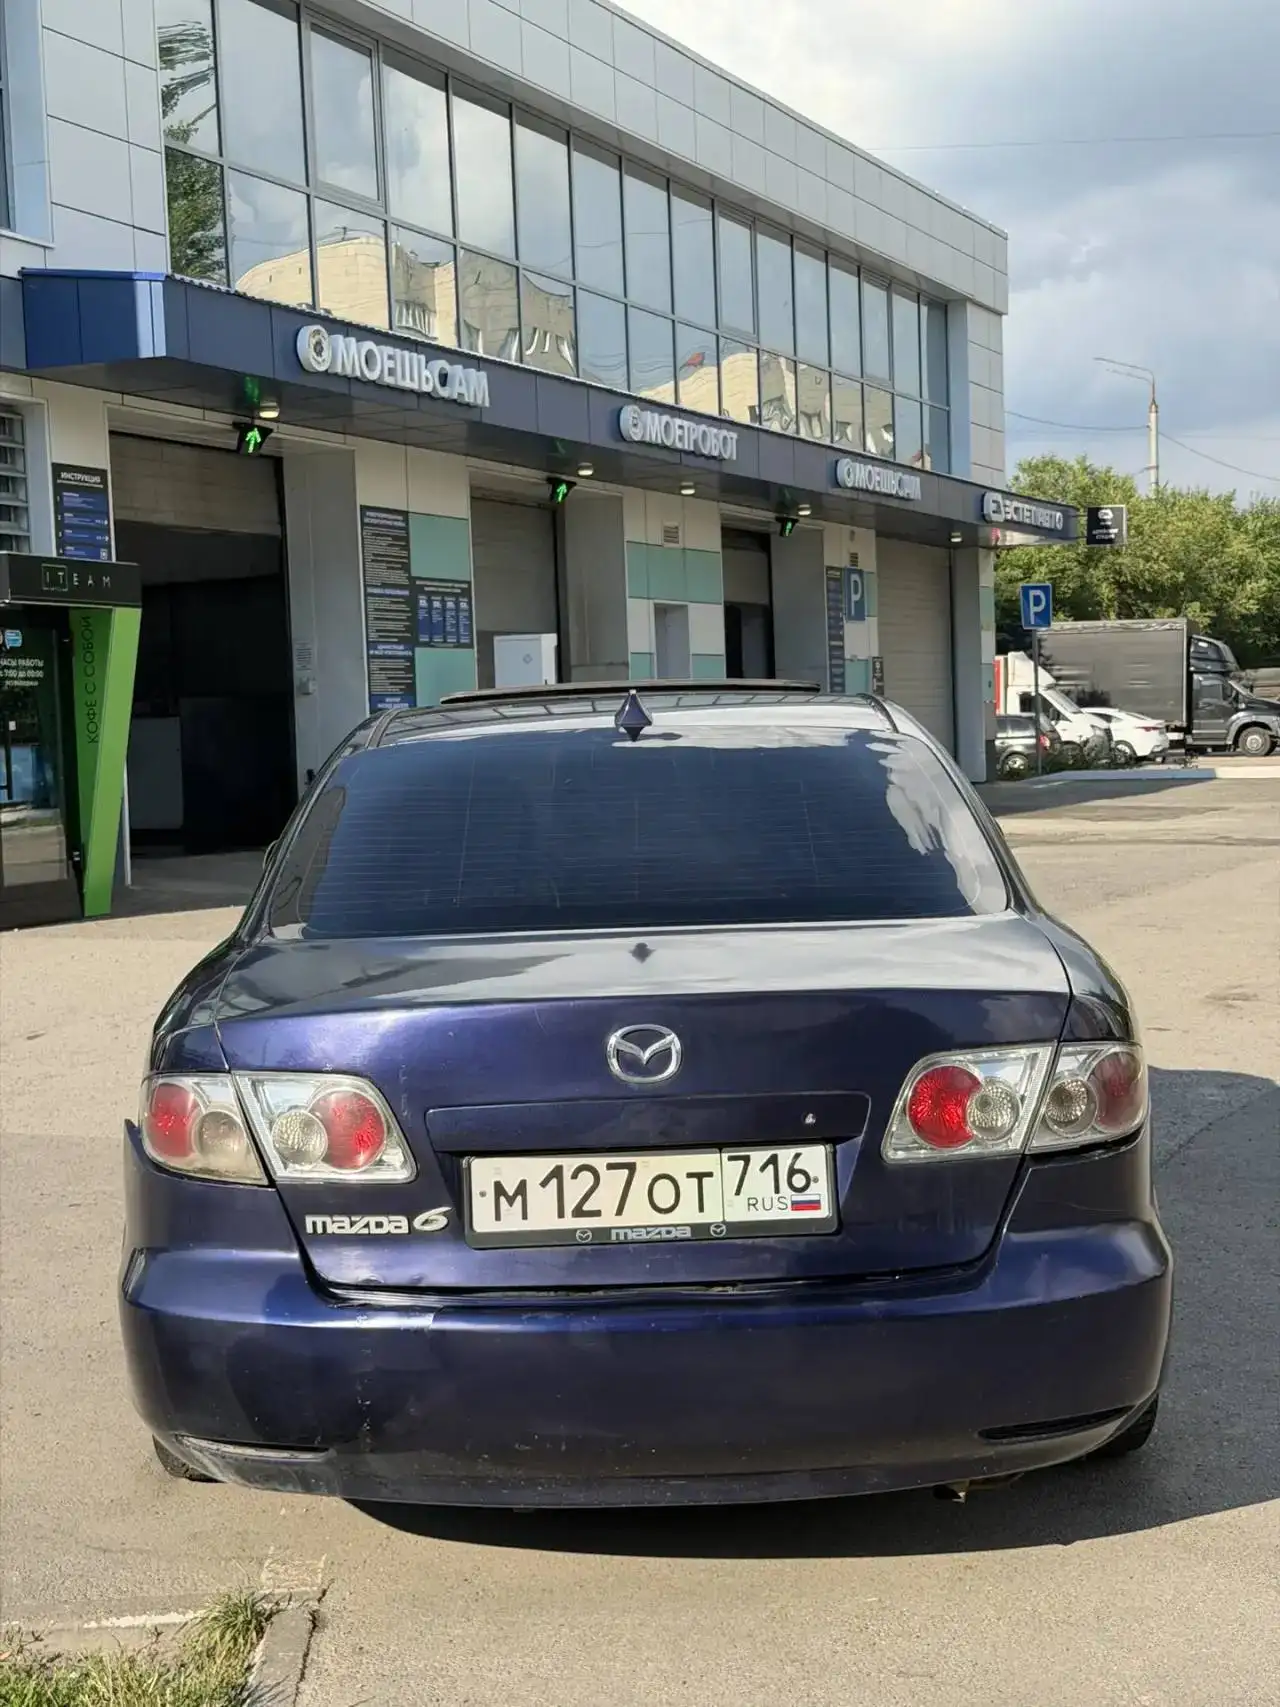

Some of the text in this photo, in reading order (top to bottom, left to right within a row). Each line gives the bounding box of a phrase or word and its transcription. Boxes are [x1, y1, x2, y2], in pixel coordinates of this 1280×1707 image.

[328, 334, 490, 407] МОЕШЬСАМ
[641, 410, 738, 460] МОЕТРОБОТ
[850, 573, 863, 617] P
[1029, 590, 1046, 625] P
[81, 615, 98, 744] КОФЕ С СОБОЙ
[727, 1152, 811, 1198] 716
[413, 1206, 452, 1231] 6
[747, 1196, 788, 1213] RUS
